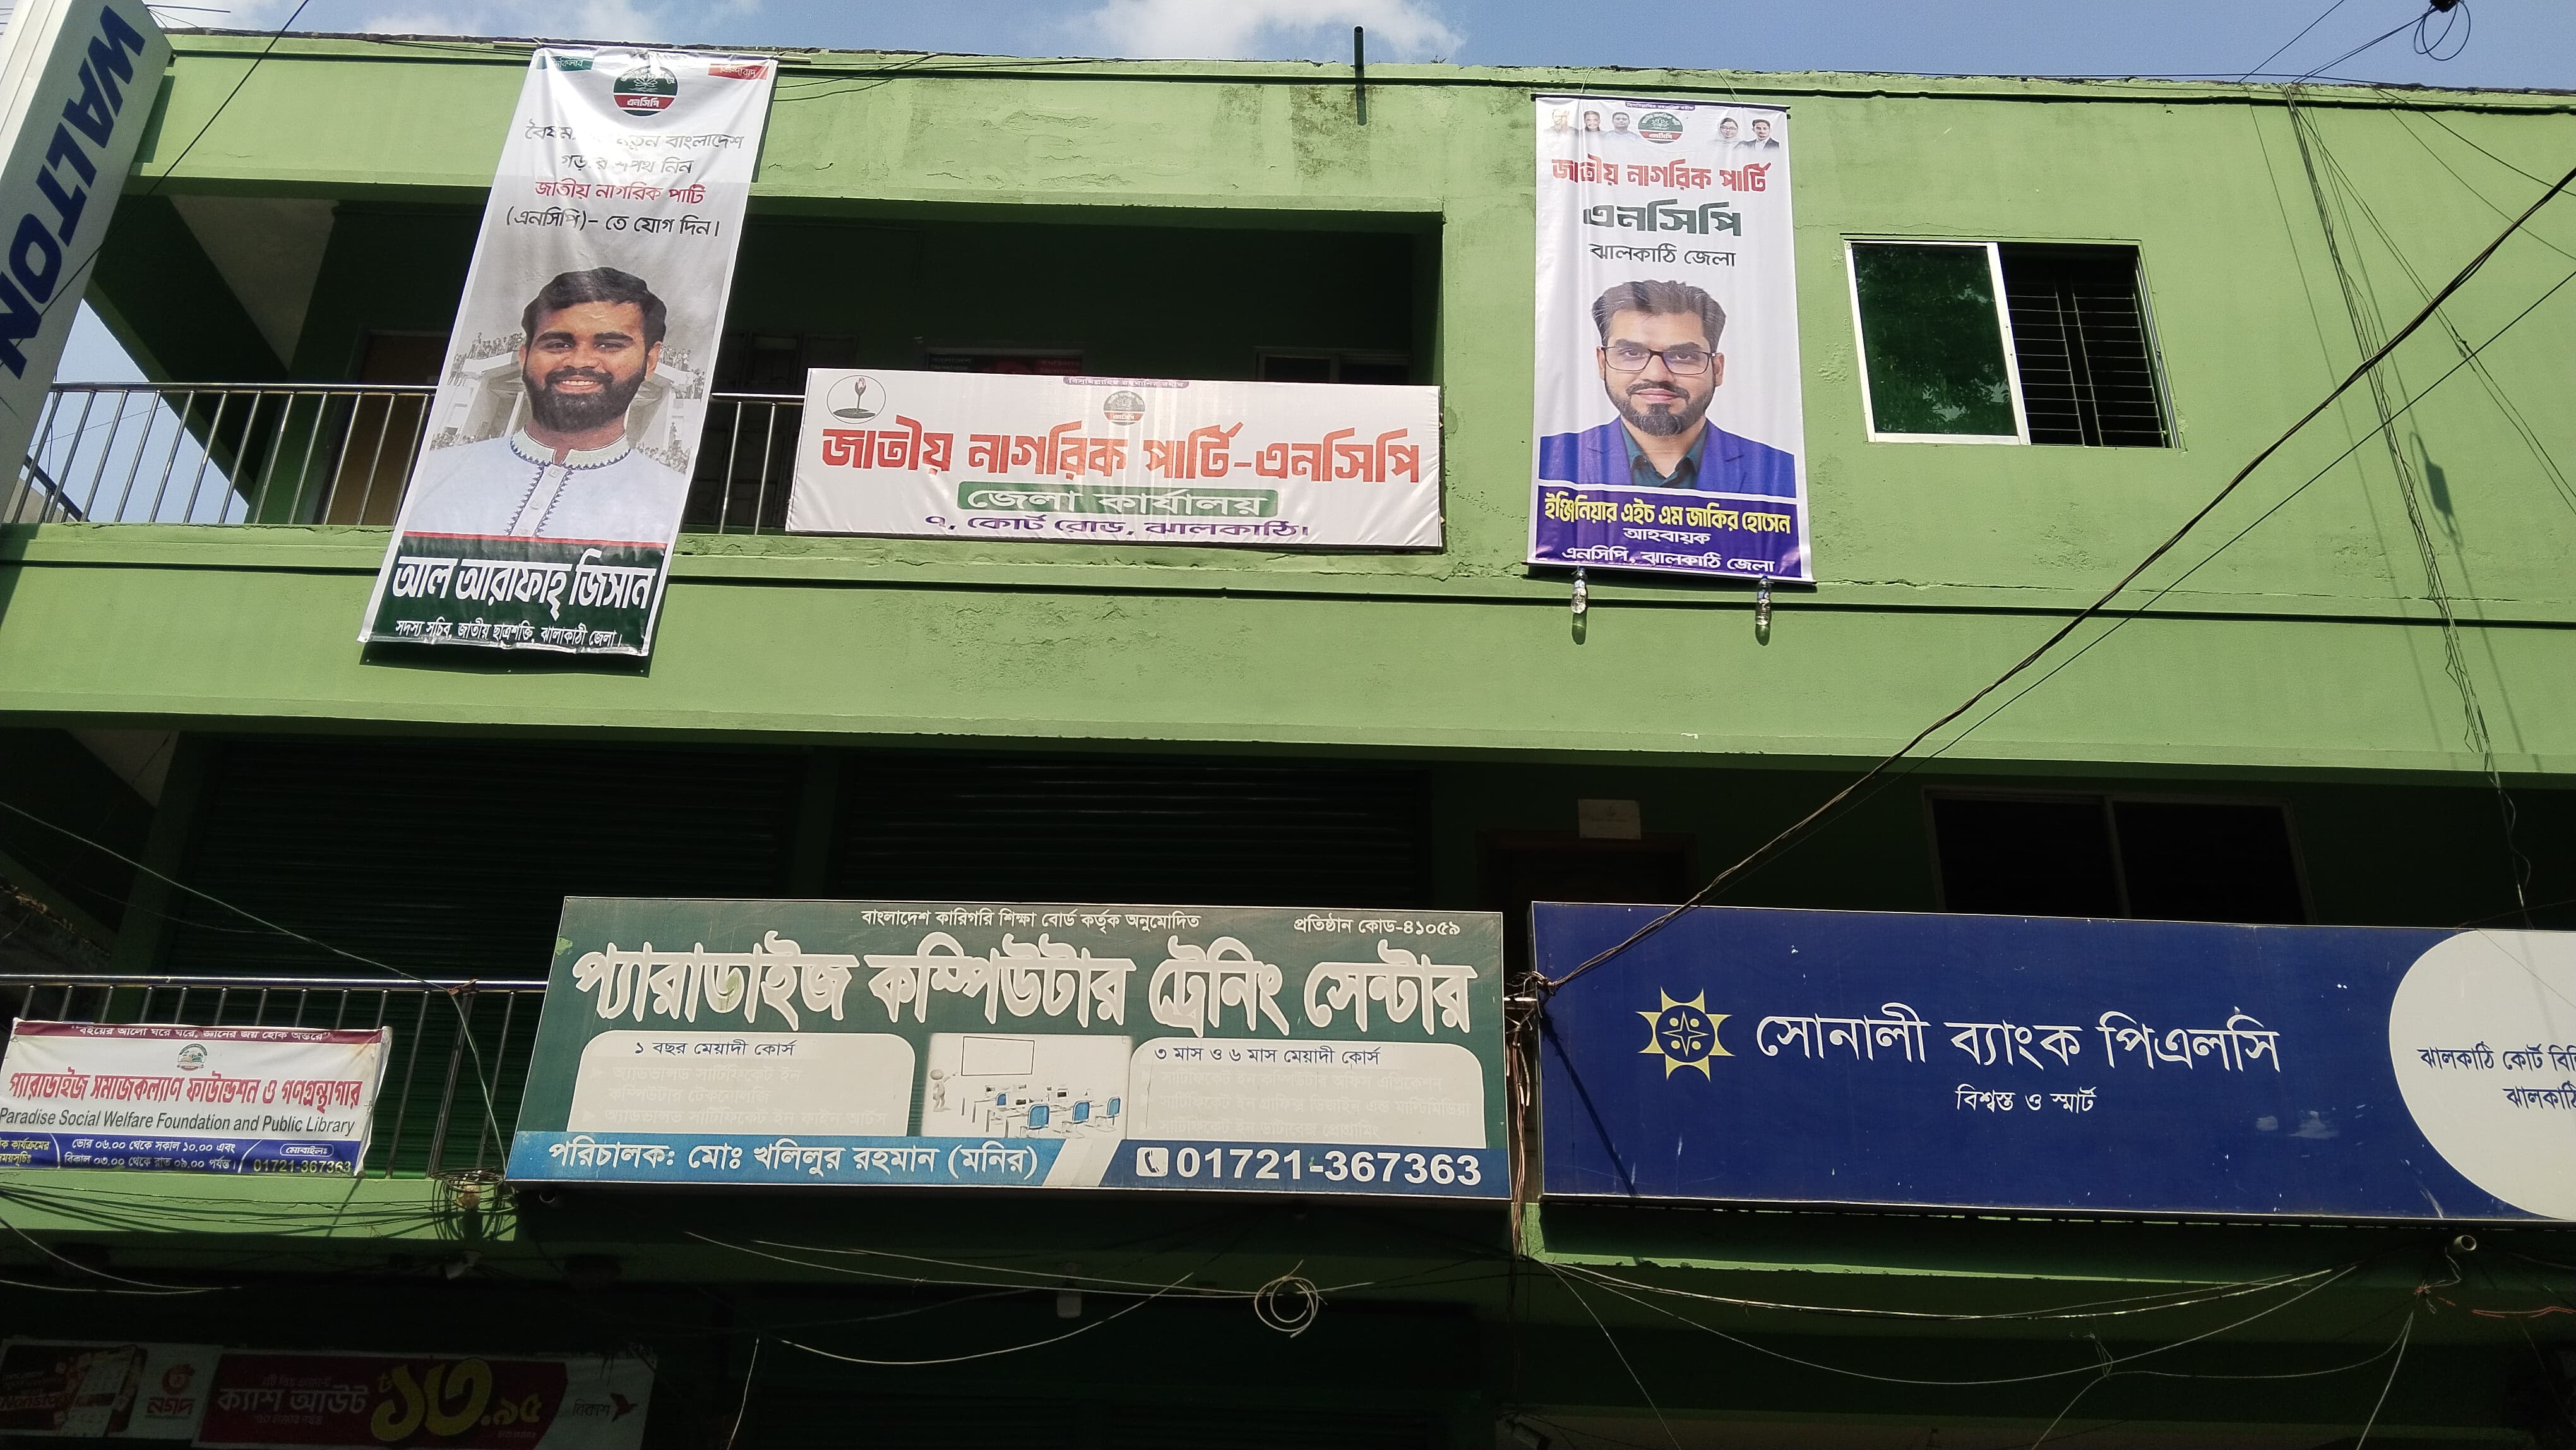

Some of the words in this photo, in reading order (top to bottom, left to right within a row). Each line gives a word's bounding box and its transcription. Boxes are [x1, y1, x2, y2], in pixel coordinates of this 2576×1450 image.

[720, 64, 756, 78] জিন্দাবাদ
[627, 97, 660, 107] এনসিপি
[665, 133, 745, 150] বাংলাদেশ
[561, 153, 607, 172] গড়র
[661, 157, 695, 174] নিন
[1551, 153, 1619, 187] জাতীয়
[1626, 158, 1712, 191] নাগরিক
[1719, 162, 1772, 193] পার্টি
[0, 5, 145, 379] WALTON
[535, 177, 592, 200] জাতীয়
[595, 181, 664, 201] নাগরিক
[605, 215, 630, 231] তে
[634, 217, 675, 234] যোগ
[1583, 198, 1743, 237] এনসিপি
[1588, 243, 1678, 264] ঝালকাঠি
[1684, 249, 1737, 268] জেলা
[822, 414, 954, 476] জাতীয়
[969, 421, 1129, 481] নাগরিক
[1143, 421, 1420, 484] পার্টি-এনসিপি
[967, 488, 1083, 512] জেলা
[1092, 488, 1269, 517] কার্যালয়
[1544, 491, 1618, 524] ইঞ্জিনিয়ার
[1621, 498, 1656, 525] এইচ
[1658, 505, 1684, 526] এম
[1685, 502, 1739, 532] জাকির
[1741, 511, 1791, 534] হোসেন
[967, 515, 1047, 532] কোর্ট
[1054, 519, 1134, 536] রোড,
[1145, 520, 1309, 537] ঝালকাঠি।
[1623, 527, 1712, 544] আহবায়ক
[1561, 544, 1636, 564] এনসিপি,
[1640, 551, 1722, 566] ঝালকাঠি
[1726, 558, 1775, 573] জেলা
[392, 555, 458, 601] আল
[568, 548, 657, 610] জিসান
[395, 620, 424, 637] সদস্য
[426, 616, 453, 640] সচিব,
[457, 617, 491, 640] জাতীয়
[493, 620, 535, 644] ছাত্রশক্তি,
[862, 909, 929, 928] বাংলাদেশ
[936, 909, 994, 928] কারিগরি
[999, 909, 1037, 928] শিক্ষা
[1042, 909, 1076, 929] বোর্ড
[1081, 910, 1121, 935] কর্তৃক
[1126, 911, 1202, 932] অনুমোদিত
[1294, 914, 1352, 935] প্রতিষ্ঠান
[1358, 918, 1461, 937] কোড-৪১০৫৯
[573, 930, 861, 1031] প্যারাডাইজ
[863, 932, 1137, 1029] কম্পিউটার
[1148, 935, 1290, 1038] ট্রেনিং
[1304, 938, 1479, 1035] সেন্টার
[117, 1028, 148, 1036] আলো
[203, 1030, 238, 1039] জ্ঞানের
[241, 1031, 261, 1039] জয়
[262, 1031, 289, 1040] হোক
[1756, 1002, 1931, 1064] সোনালী
[1943, 1017, 2084, 1070] ব্যাংক
[2096, 1010, 2281, 1074] পিএলসি
[634, 1043, 643, 1055] ১
[653, 1041, 687, 1057] বছর
[694, 1039, 747, 1058] মেয়াদী
[754, 1040, 796, 1057] কোর্স
[1155, 1048, 1166, 1061] ৩
[1174, 1046, 1205, 1063] মাস
[1210, 1048, 1223, 1061] ও
[1229, 1049, 1241, 1062] ৬
[1246, 1048, 1277, 1064] মাস
[1283, 1045, 1335, 1065] মেয়াদী
[1341, 1047, 1381, 1066] কোর্স
[2416, 1041, 2495, 1070] ঝালকাঠি
[2502, 1043, 2544, 1072] কোর্ট
[9, 1067, 92, 1101] প্যারাডাইজ
[90, 1074, 186, 1103] সমাজকল্যাণ
[263, 1079, 278, 1104] ও
[282, 1079, 364, 1115] গণগ্রন্থাগার
[1955, 1083, 2016, 1113] বিশ্বস্ত
[2025, 1093, 2042, 1111] ও
[2050, 1086, 2098, 1114] স্মার্ট
[0, 1107, 56, 1125] Paradise
[59, 1109, 102, 1127] Social
[104, 1110, 153, 1128] Welfare
[156, 1112, 230, 1131] Foundation
[234, 1115, 260, 1132] and
[262, 1115, 303, 1132] Public
[306, 1117, 355, 1137] Library
[72, 1139, 94, 1150] ভোর
[95, 1141, 126, 1151] ০৬.০০
[129, 1140, 153, 1151] থেকে
[155, 1140, 181, 1152] সকাল
[182, 1141, 213, 1152] ১০.০০
[217, 1142, 236, 1154] এবং
[285, 1145, 328, 1156] মোবাইলঃ
[688, 1142, 741, 1171] মোঃ
[754, 1137, 846, 1178] খলিলুর
[852, 1146, 939, 1175] রহমান
[948, 1139, 1038, 1179] (মনির)
[64, 1152, 92, 1164] বিকাল
[128, 1156, 153, 1168] থেকে
[154, 1156, 172, 1168] রাত
[253, 1158, 352, 1174] 01721-367363
[1176, 1146, 1482, 1187] 01721-367363
[146, 1397, 196, 1415] নগদ
[217, 1387, 285, 1413] ক্যাশ
[290, 1383, 369, 1415] আউট
[572, 1398, 612, 1418] বিকাশ
